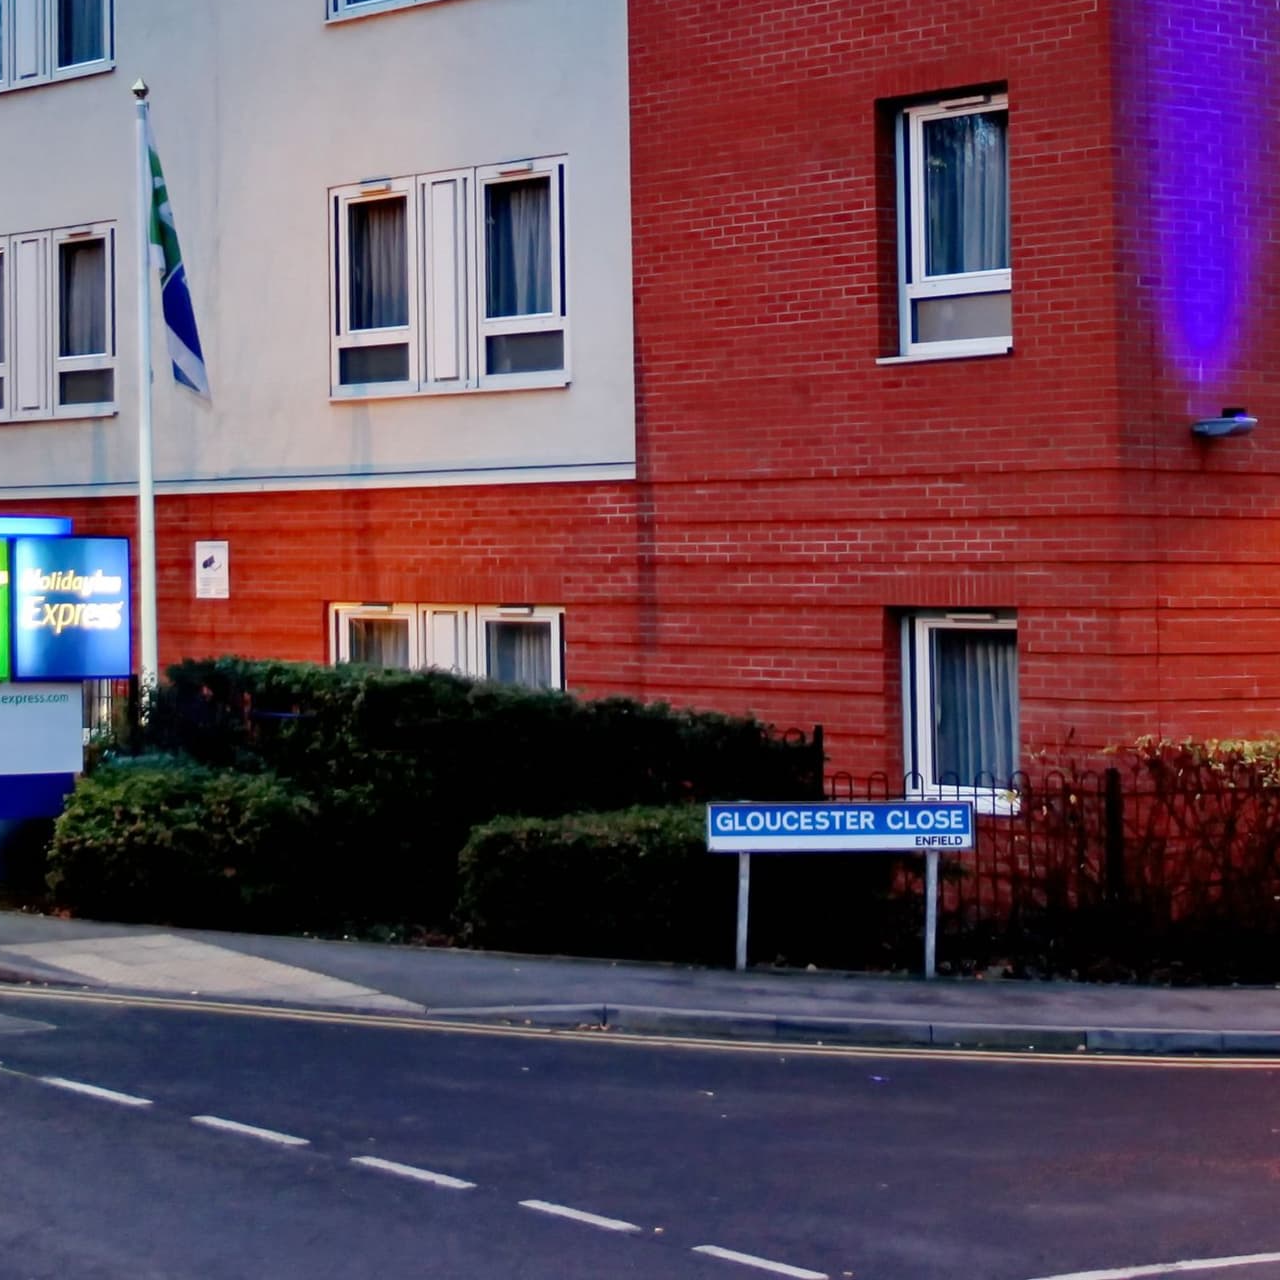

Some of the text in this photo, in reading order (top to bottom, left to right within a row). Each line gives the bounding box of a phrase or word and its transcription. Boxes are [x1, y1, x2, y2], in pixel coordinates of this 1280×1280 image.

[22, 596, 124, 635] Express
[716, 809, 964, 831] GLOUCESTER CLOSE
[914, 835, 963, 847] ENFIELD
